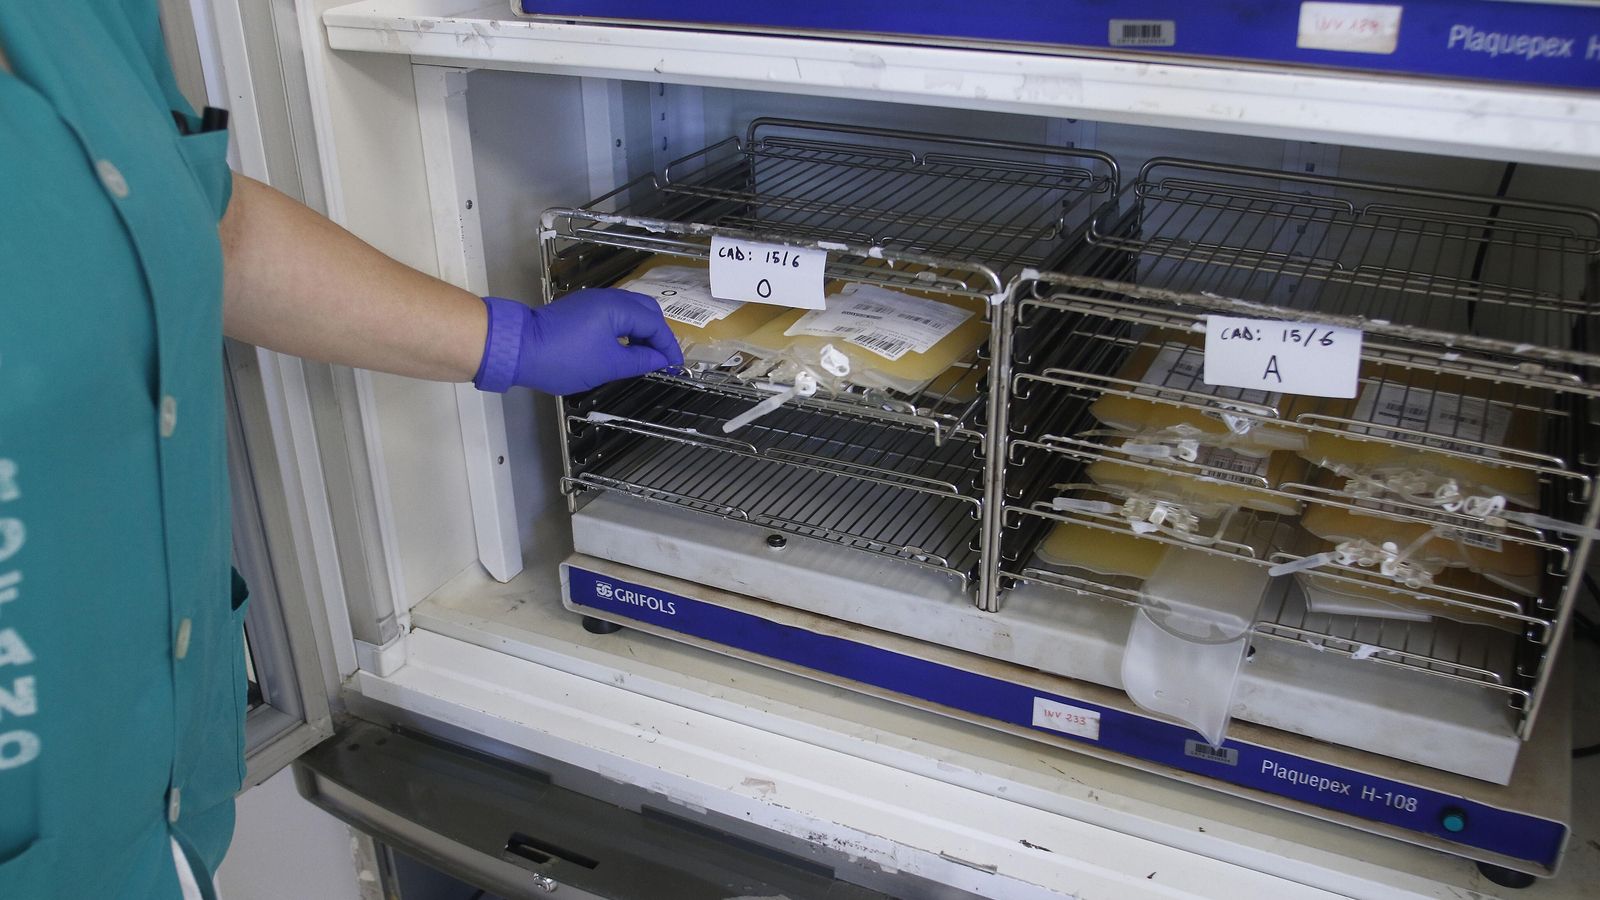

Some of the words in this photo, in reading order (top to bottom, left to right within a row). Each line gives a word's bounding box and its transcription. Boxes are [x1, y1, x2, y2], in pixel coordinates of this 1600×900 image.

[1447, 24, 1574, 60] Plaquepex
[719, 246, 752, 261] CAD:
[766, 251, 800, 268] 15/6
[1221, 326, 1261, 341] CAD:
[1282, 328, 1334, 347] 15/6
[1263, 355, 1282, 383] A
[614, 588, 676, 615] GRIFOLS
[1044, 709, 1061, 718] INV
[1065, 713, 1086, 725] 233
[1261, 759, 1352, 795] Plaquepex
[1361, 785, 1418, 813] H-108
